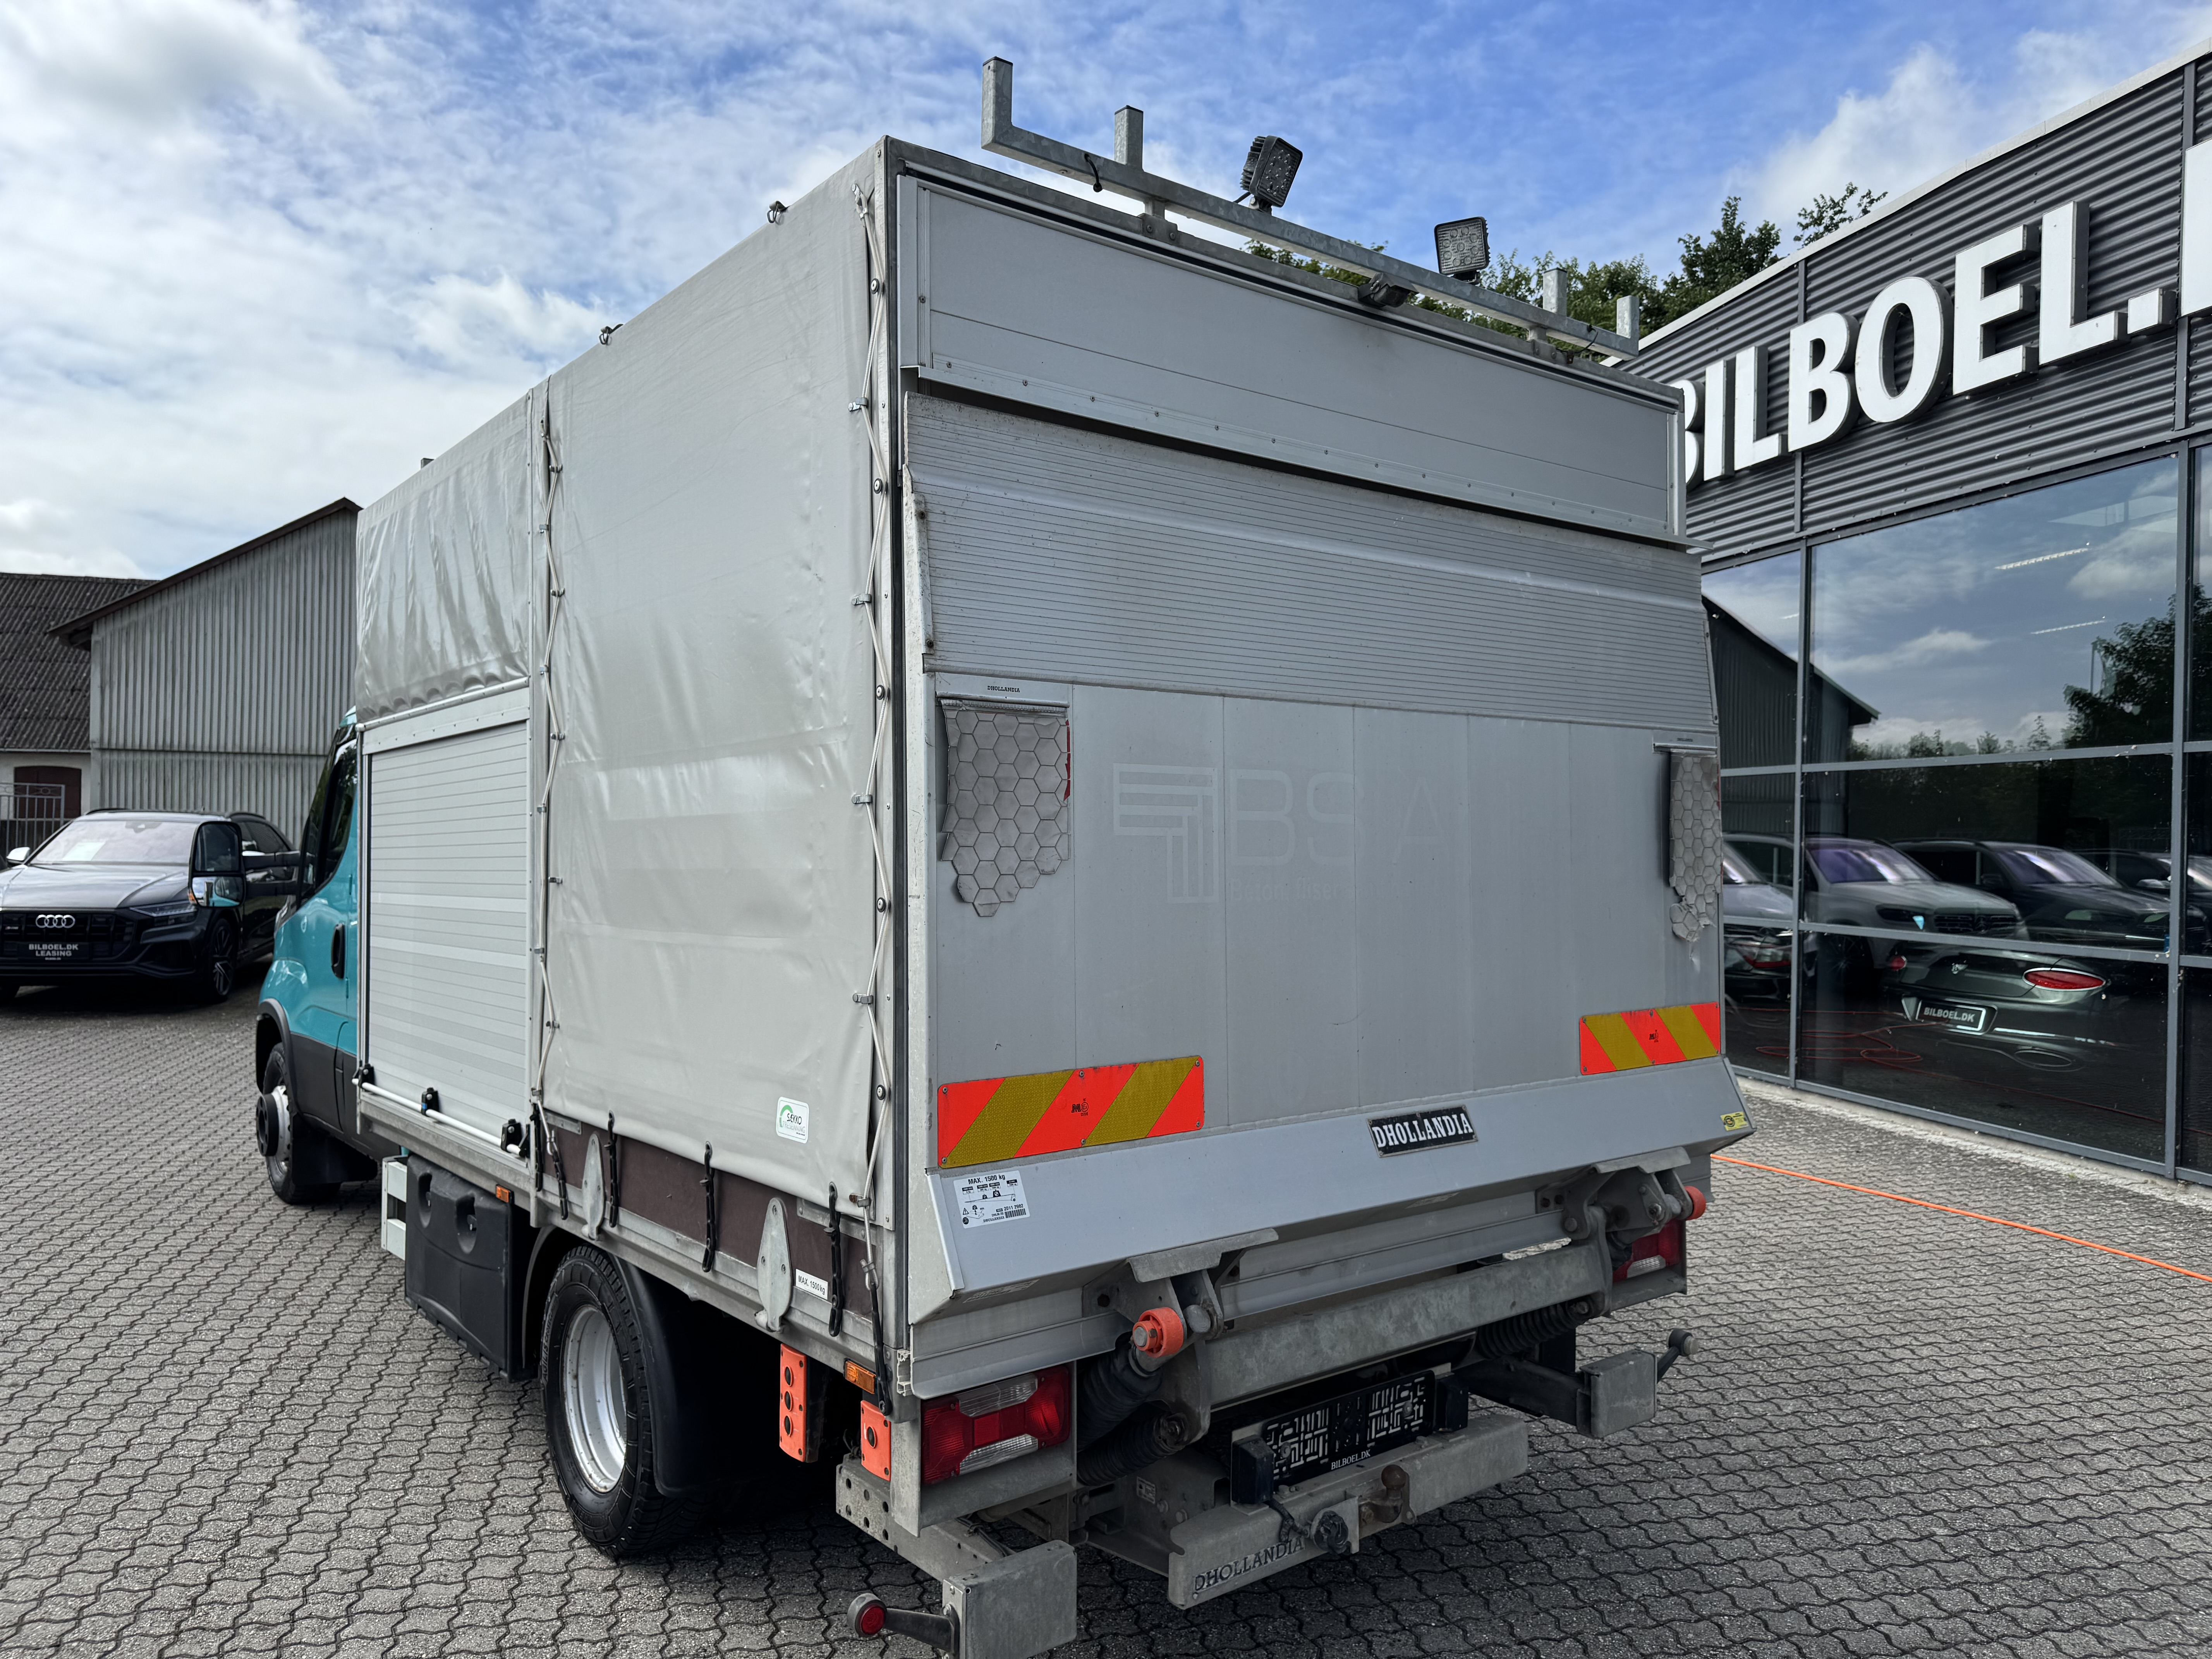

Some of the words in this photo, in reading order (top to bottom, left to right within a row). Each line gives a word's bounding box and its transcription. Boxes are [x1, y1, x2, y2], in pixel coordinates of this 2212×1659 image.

[1924, 1006, 1975, 1023] BILBOEL.DK
[1372, 1113, 1473, 1148] DHOLLANDIA
[799, 1275, 809, 1286] MAX.
[1331, 1449, 1371, 1470] BILBOEL.DK
[1195, 1537, 1304, 1591] DHOLLANDIA
